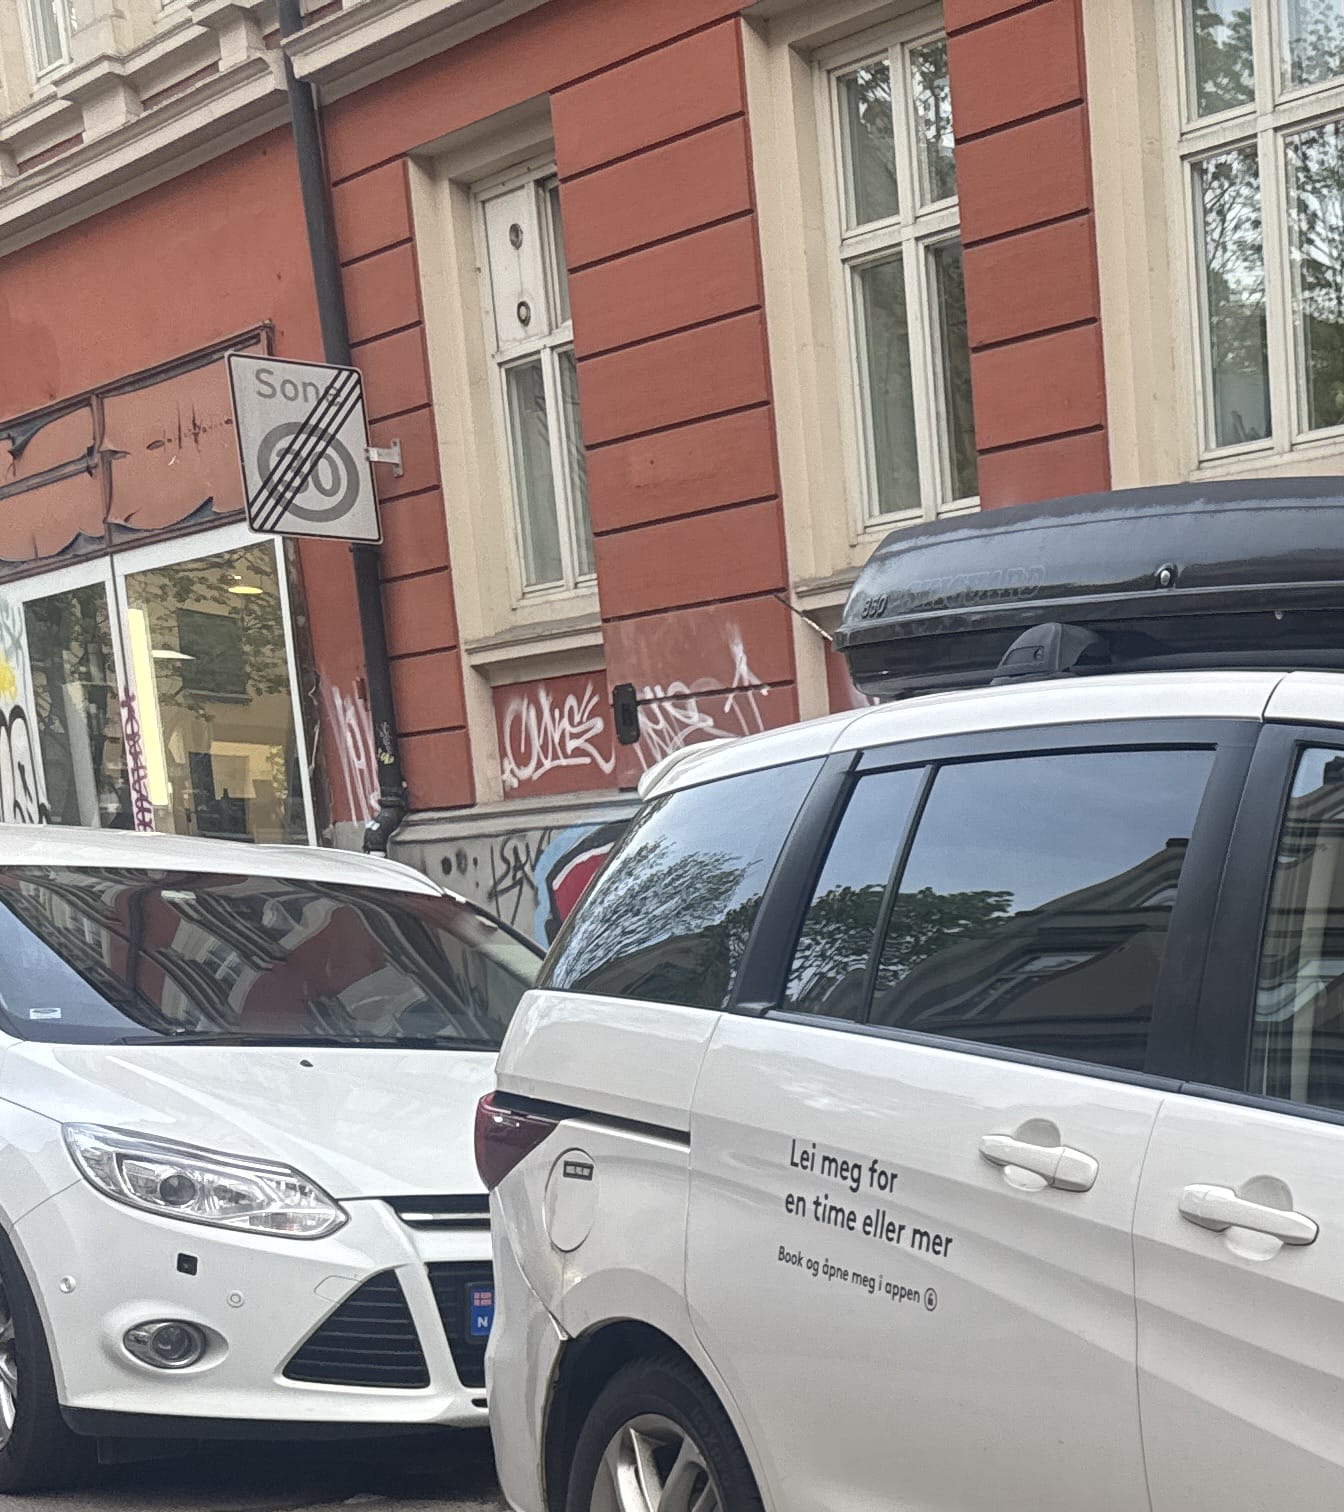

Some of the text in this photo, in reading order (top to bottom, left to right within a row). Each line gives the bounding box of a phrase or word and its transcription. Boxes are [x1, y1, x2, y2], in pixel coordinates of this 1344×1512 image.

[789, 1138, 898, 1193] Lei meg for
[785, 1193, 953, 1257] en time eller mer
[778, 1245, 921, 1303] Book og åpne meg i appen
[477, 1316, 489, 1328] N
